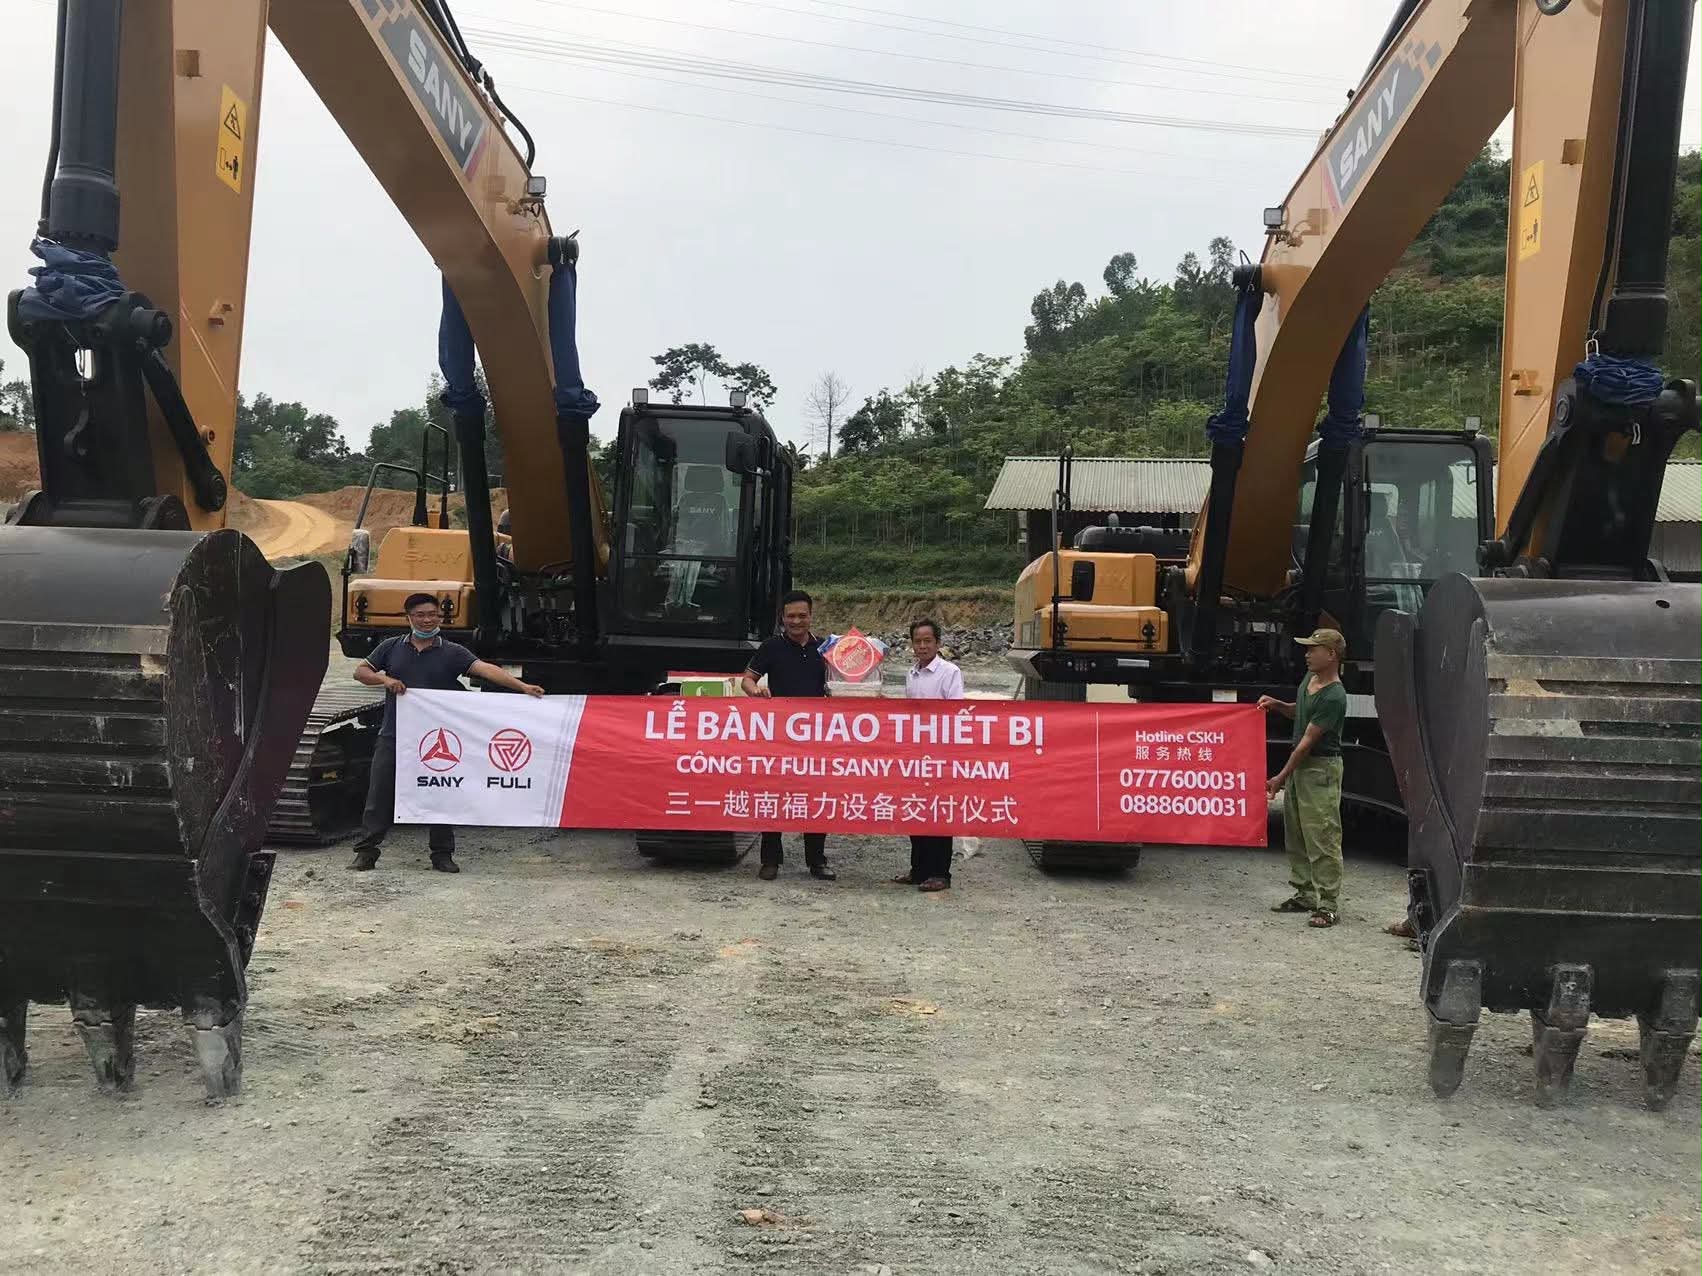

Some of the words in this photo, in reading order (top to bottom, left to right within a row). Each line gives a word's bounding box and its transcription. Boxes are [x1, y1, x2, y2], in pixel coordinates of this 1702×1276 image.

[408, 28, 472, 151] SANY
[1340, 67, 1400, 190] SANY
[645, 699, 687, 741] LỄ
[697, 705, 775, 742] BÀN
[785, 711, 880, 743] GIAO
[888, 705, 998, 745] THIẾT
[1009, 715, 1044, 756] BỊ
[1135, 730, 1184, 743] Hotline
[1187, 731, 1224, 744] CSKH
[1135, 745, 1213, 762] 服务热线
[676, 750, 742, 775] CÔNG
[747, 756, 777, 776] TY
[781, 756, 826, 777] FULI
[831, 757, 894, 777] SANY
[899, 754, 947, 787] VIỆT
[952, 760, 1009, 780] NAM
[1119, 768, 1247, 791] 0777600031
[416, 775, 464, 788] SANY
[486, 776, 531, 789] FULI
[665, 789, 1019, 825] 三一越南福力设备交付仪式
[1119, 794, 1247, 817] 0888600031
